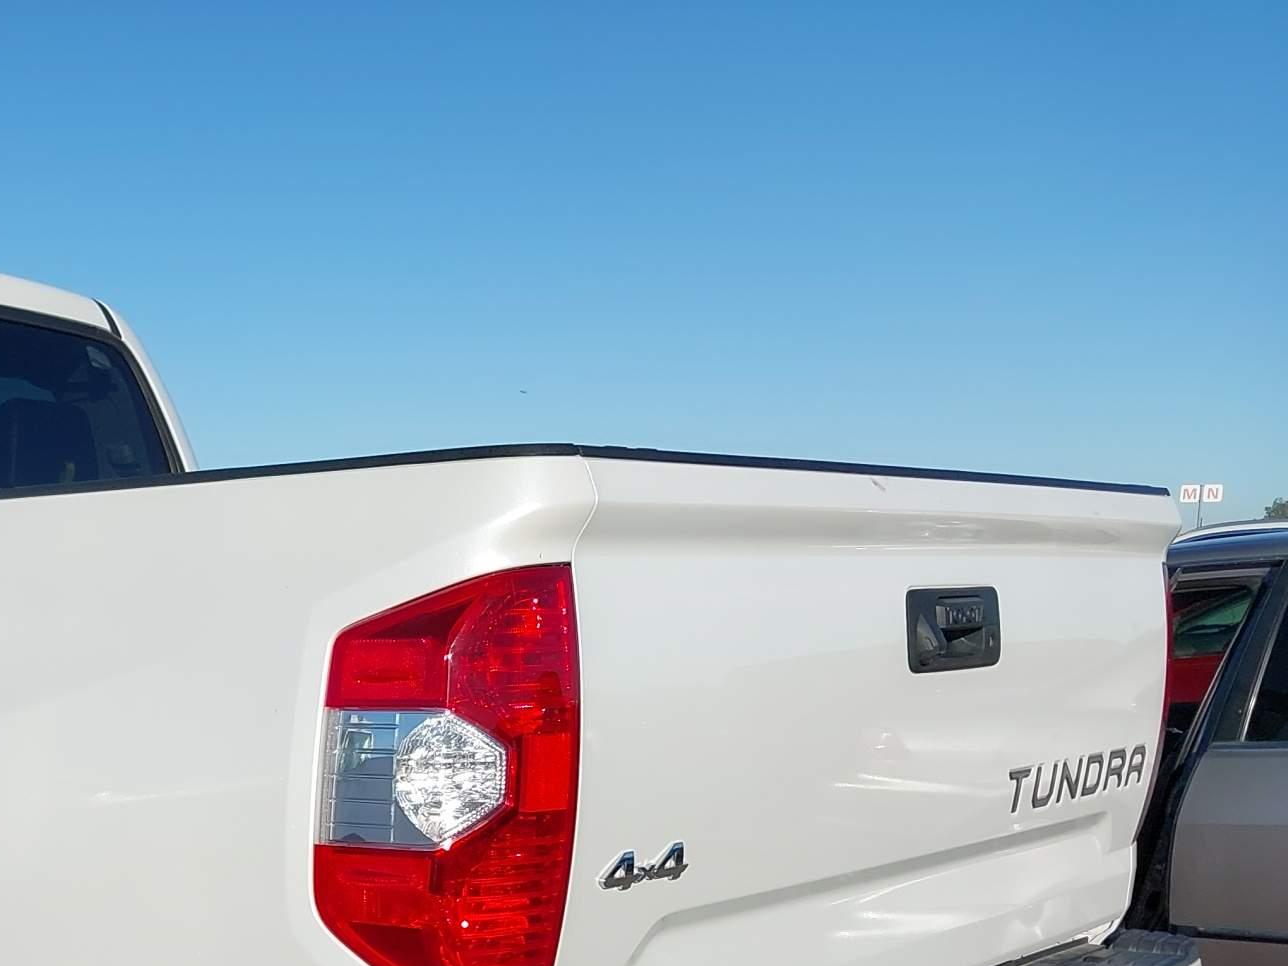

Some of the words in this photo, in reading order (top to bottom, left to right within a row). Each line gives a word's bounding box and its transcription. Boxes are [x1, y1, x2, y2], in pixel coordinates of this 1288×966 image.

[1182, 487, 1198, 501] M
[1207, 487, 1220, 500] N
[1009, 743, 1148, 814] TUNDRA
[597, 841, 689, 891] 4x4
